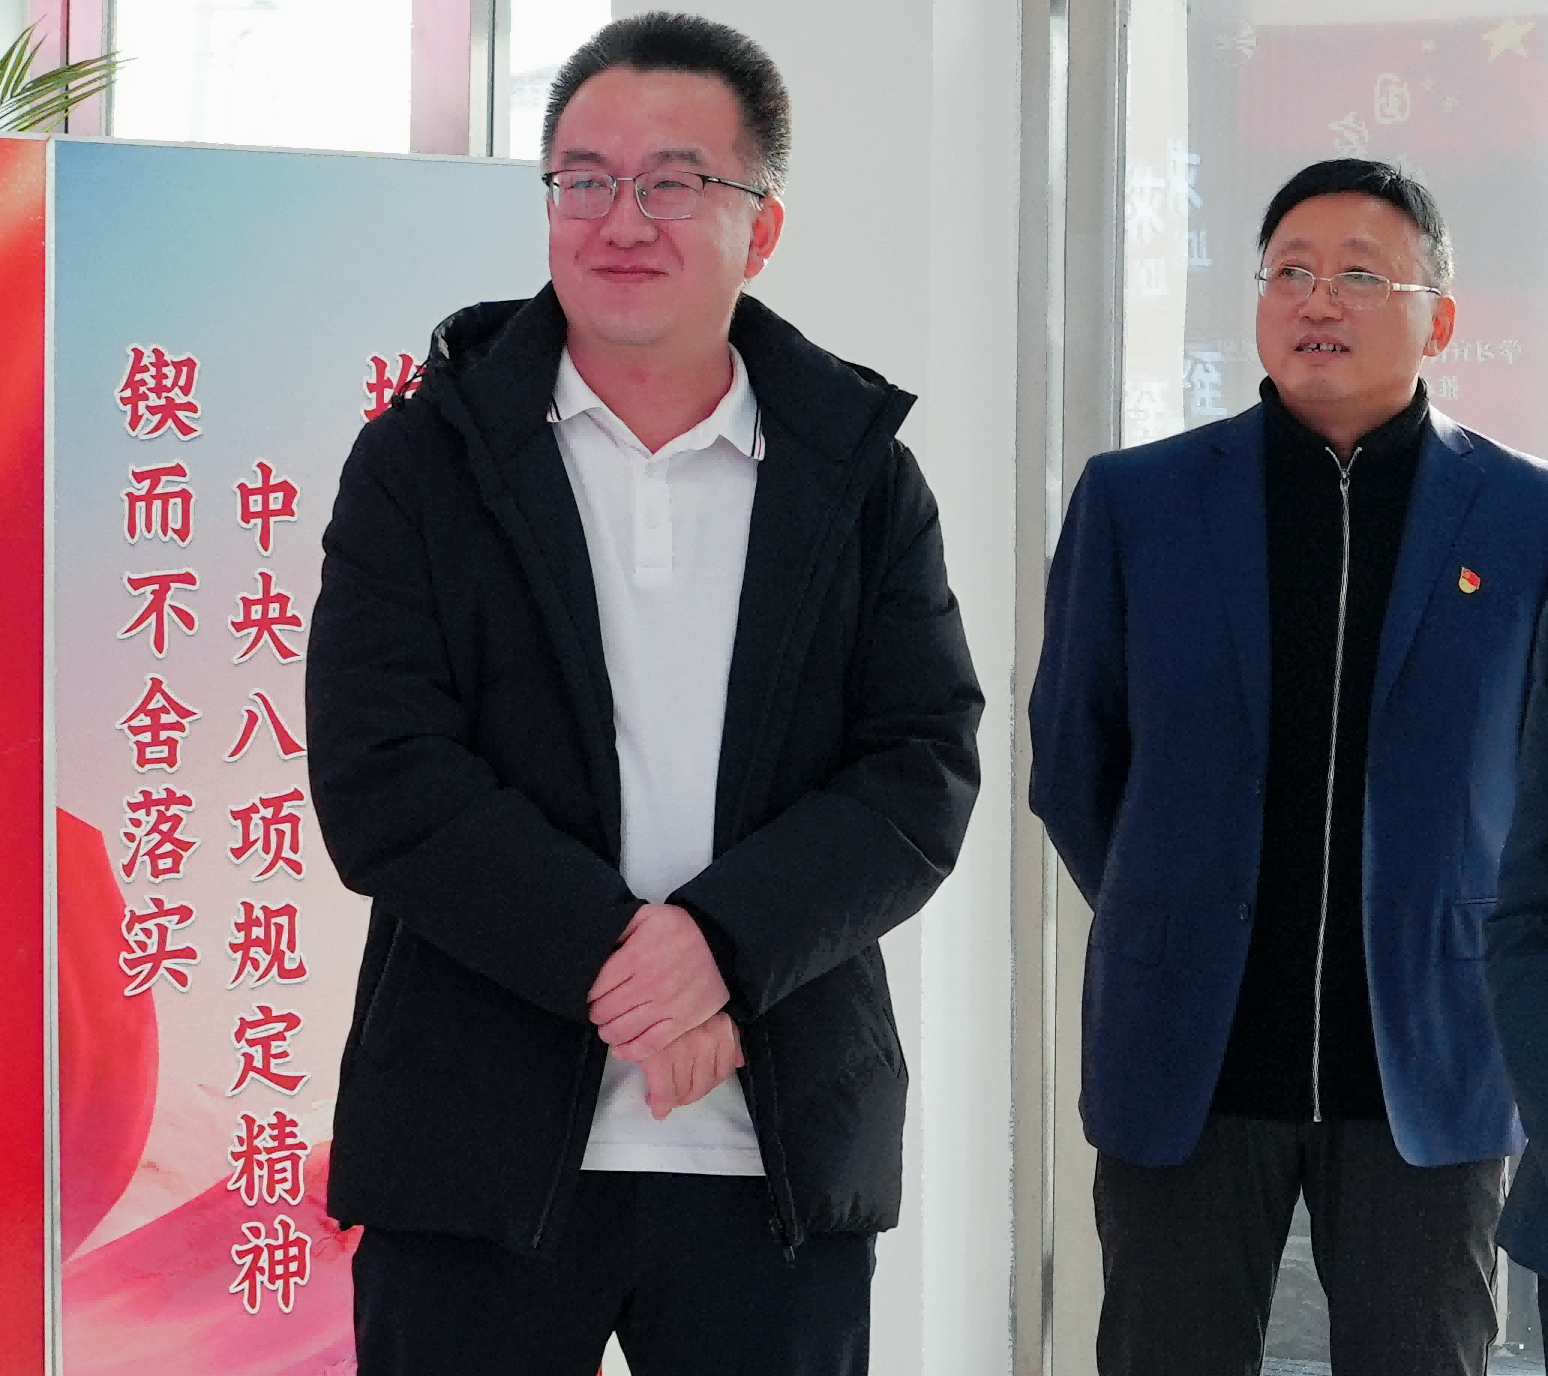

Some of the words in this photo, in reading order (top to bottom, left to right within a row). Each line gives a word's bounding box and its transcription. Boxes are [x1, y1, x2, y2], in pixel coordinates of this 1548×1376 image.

[115, 345, 200, 1000] 锲而不舍落实
[228, 459, 310, 1315] 中央八项规定精神
